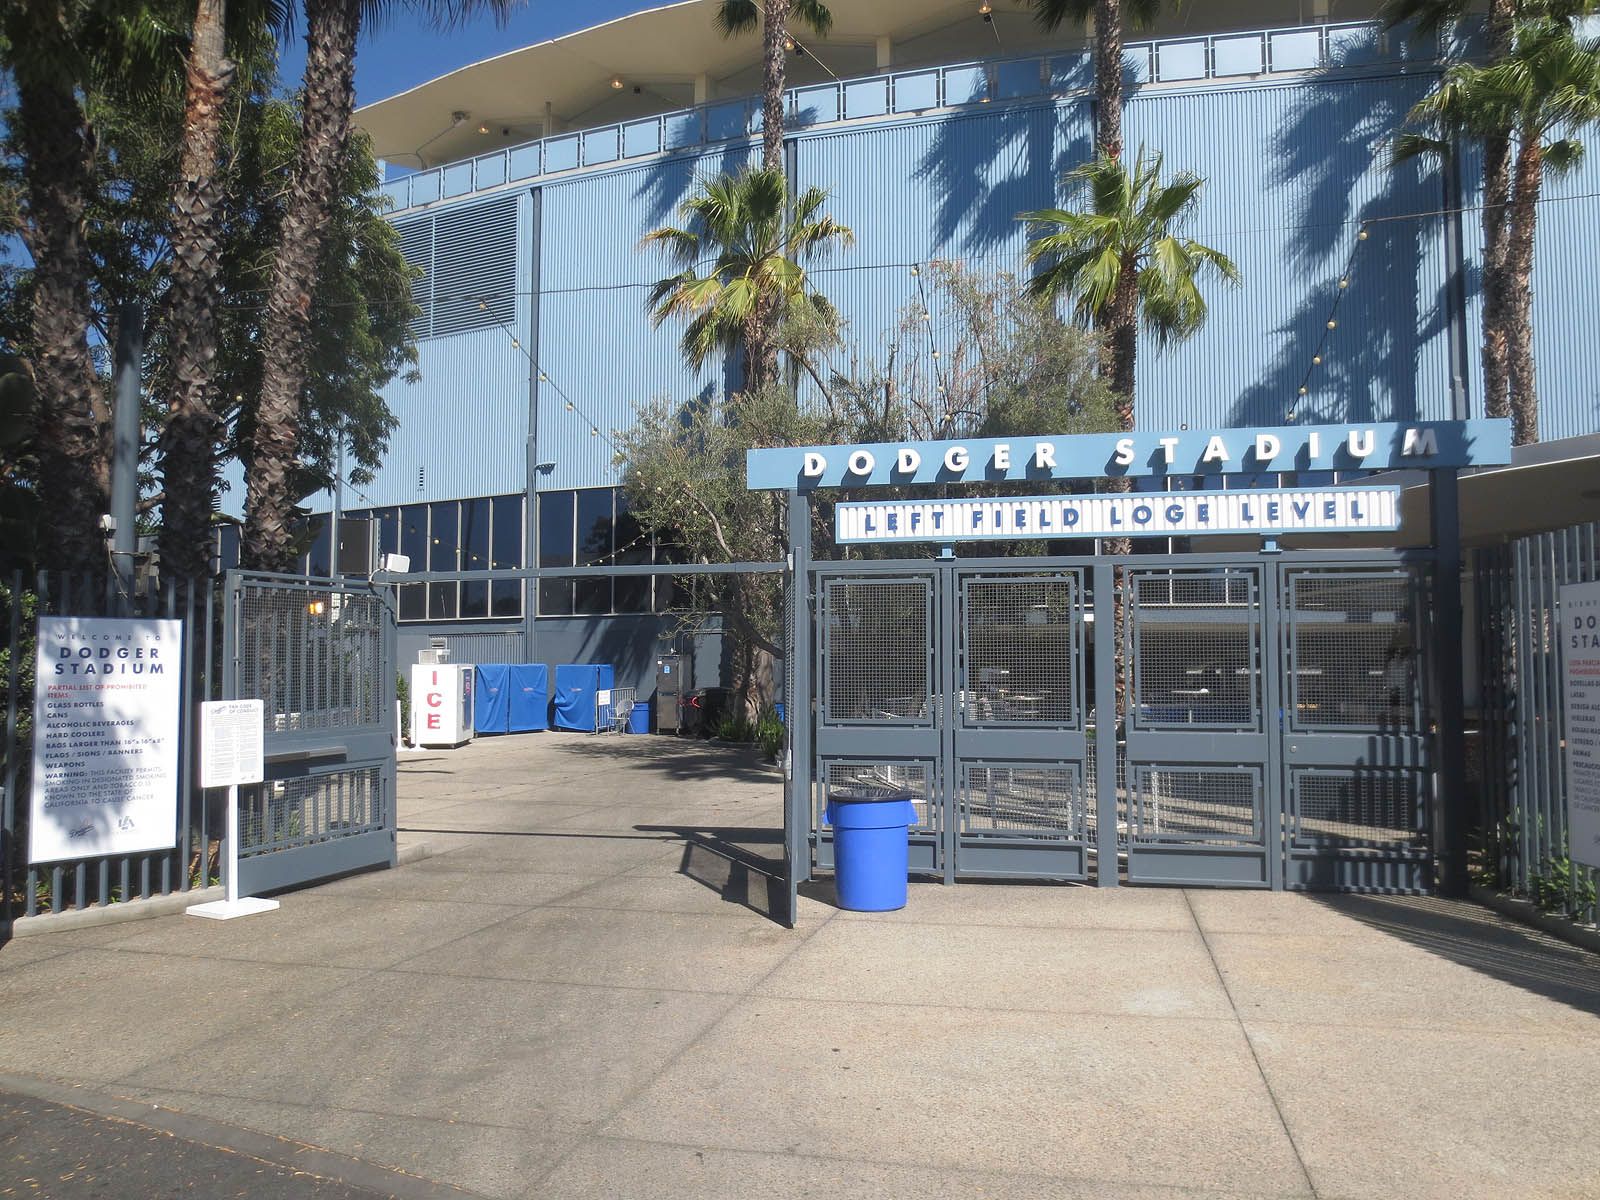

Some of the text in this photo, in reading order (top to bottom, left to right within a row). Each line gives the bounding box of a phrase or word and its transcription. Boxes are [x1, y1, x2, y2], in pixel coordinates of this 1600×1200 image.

[804, 428, 1439, 477] DODGER STADIUM
[865, 500, 1364, 532] LEFT FIELD LOGE LEVEL
[60, 647, 159, 659] DODGER
[54, 663, 164, 675] STADIUM
[427, 670, 442, 730] ICE
[46, 721, 91, 729] ALCOHOLIC
[70, 730, 105, 738] COOLERS
[69, 740, 98, 748] LARGER
[108, 748, 144, 756] BANNERS
[45, 761, 86, 769] WEAPONS
[45, 771, 88, 779] WARNING:
[106, 768, 134, 776] FACILITY
[44, 778, 81, 787] SMOKING
[92, 775, 134, 783] DESIGNATED
[44, 786, 69, 794] AREAS
[94, 783, 108, 791] AND
[44, 792, 75, 801] KNOWN
[89, 790, 102, 798] THE
[44, 799, 89, 809] CALIFORNIA
[102, 796, 124, 804] CAUSE
